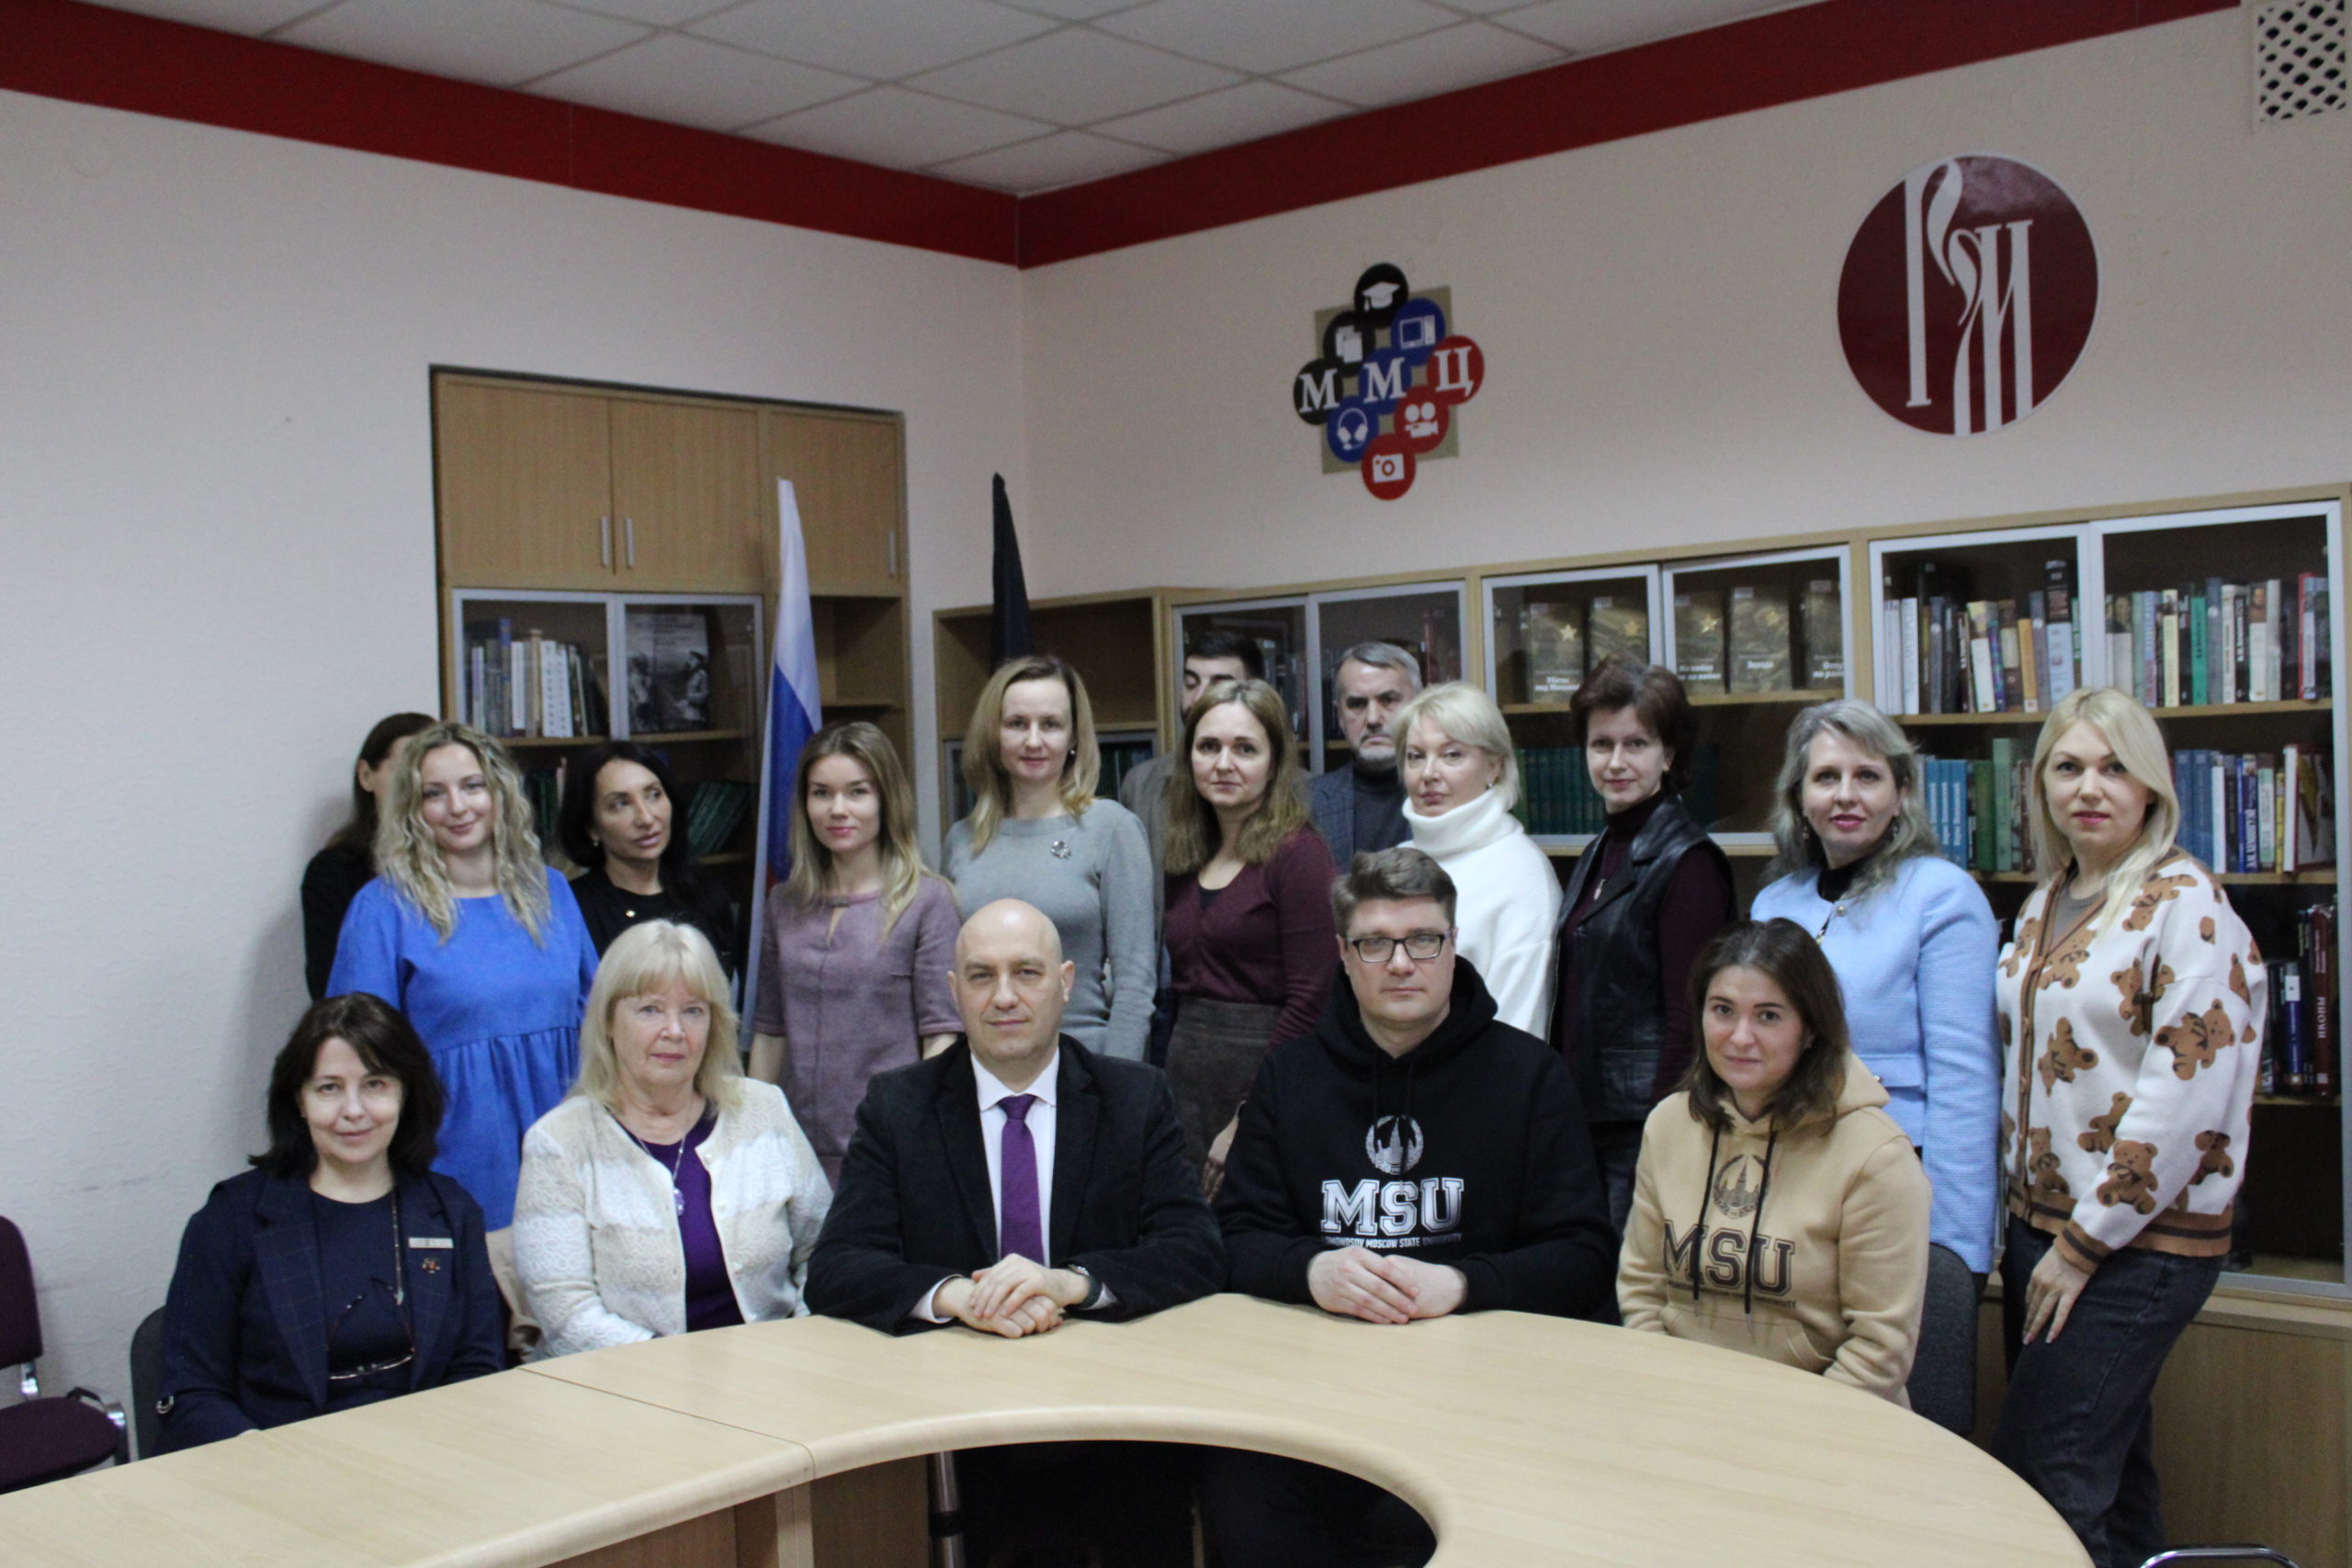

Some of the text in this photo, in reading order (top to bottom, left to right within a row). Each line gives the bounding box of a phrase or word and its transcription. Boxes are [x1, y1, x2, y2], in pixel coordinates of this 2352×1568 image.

[1298, 345, 1474, 413] ММЦ
[1320, 1177, 1464, 1236] MSU
[1364, 1238, 1398, 1248] MOSCOW
[1398, 1237, 1421, 1248] STATE
[1663, 1219, 1795, 1297] MSU
